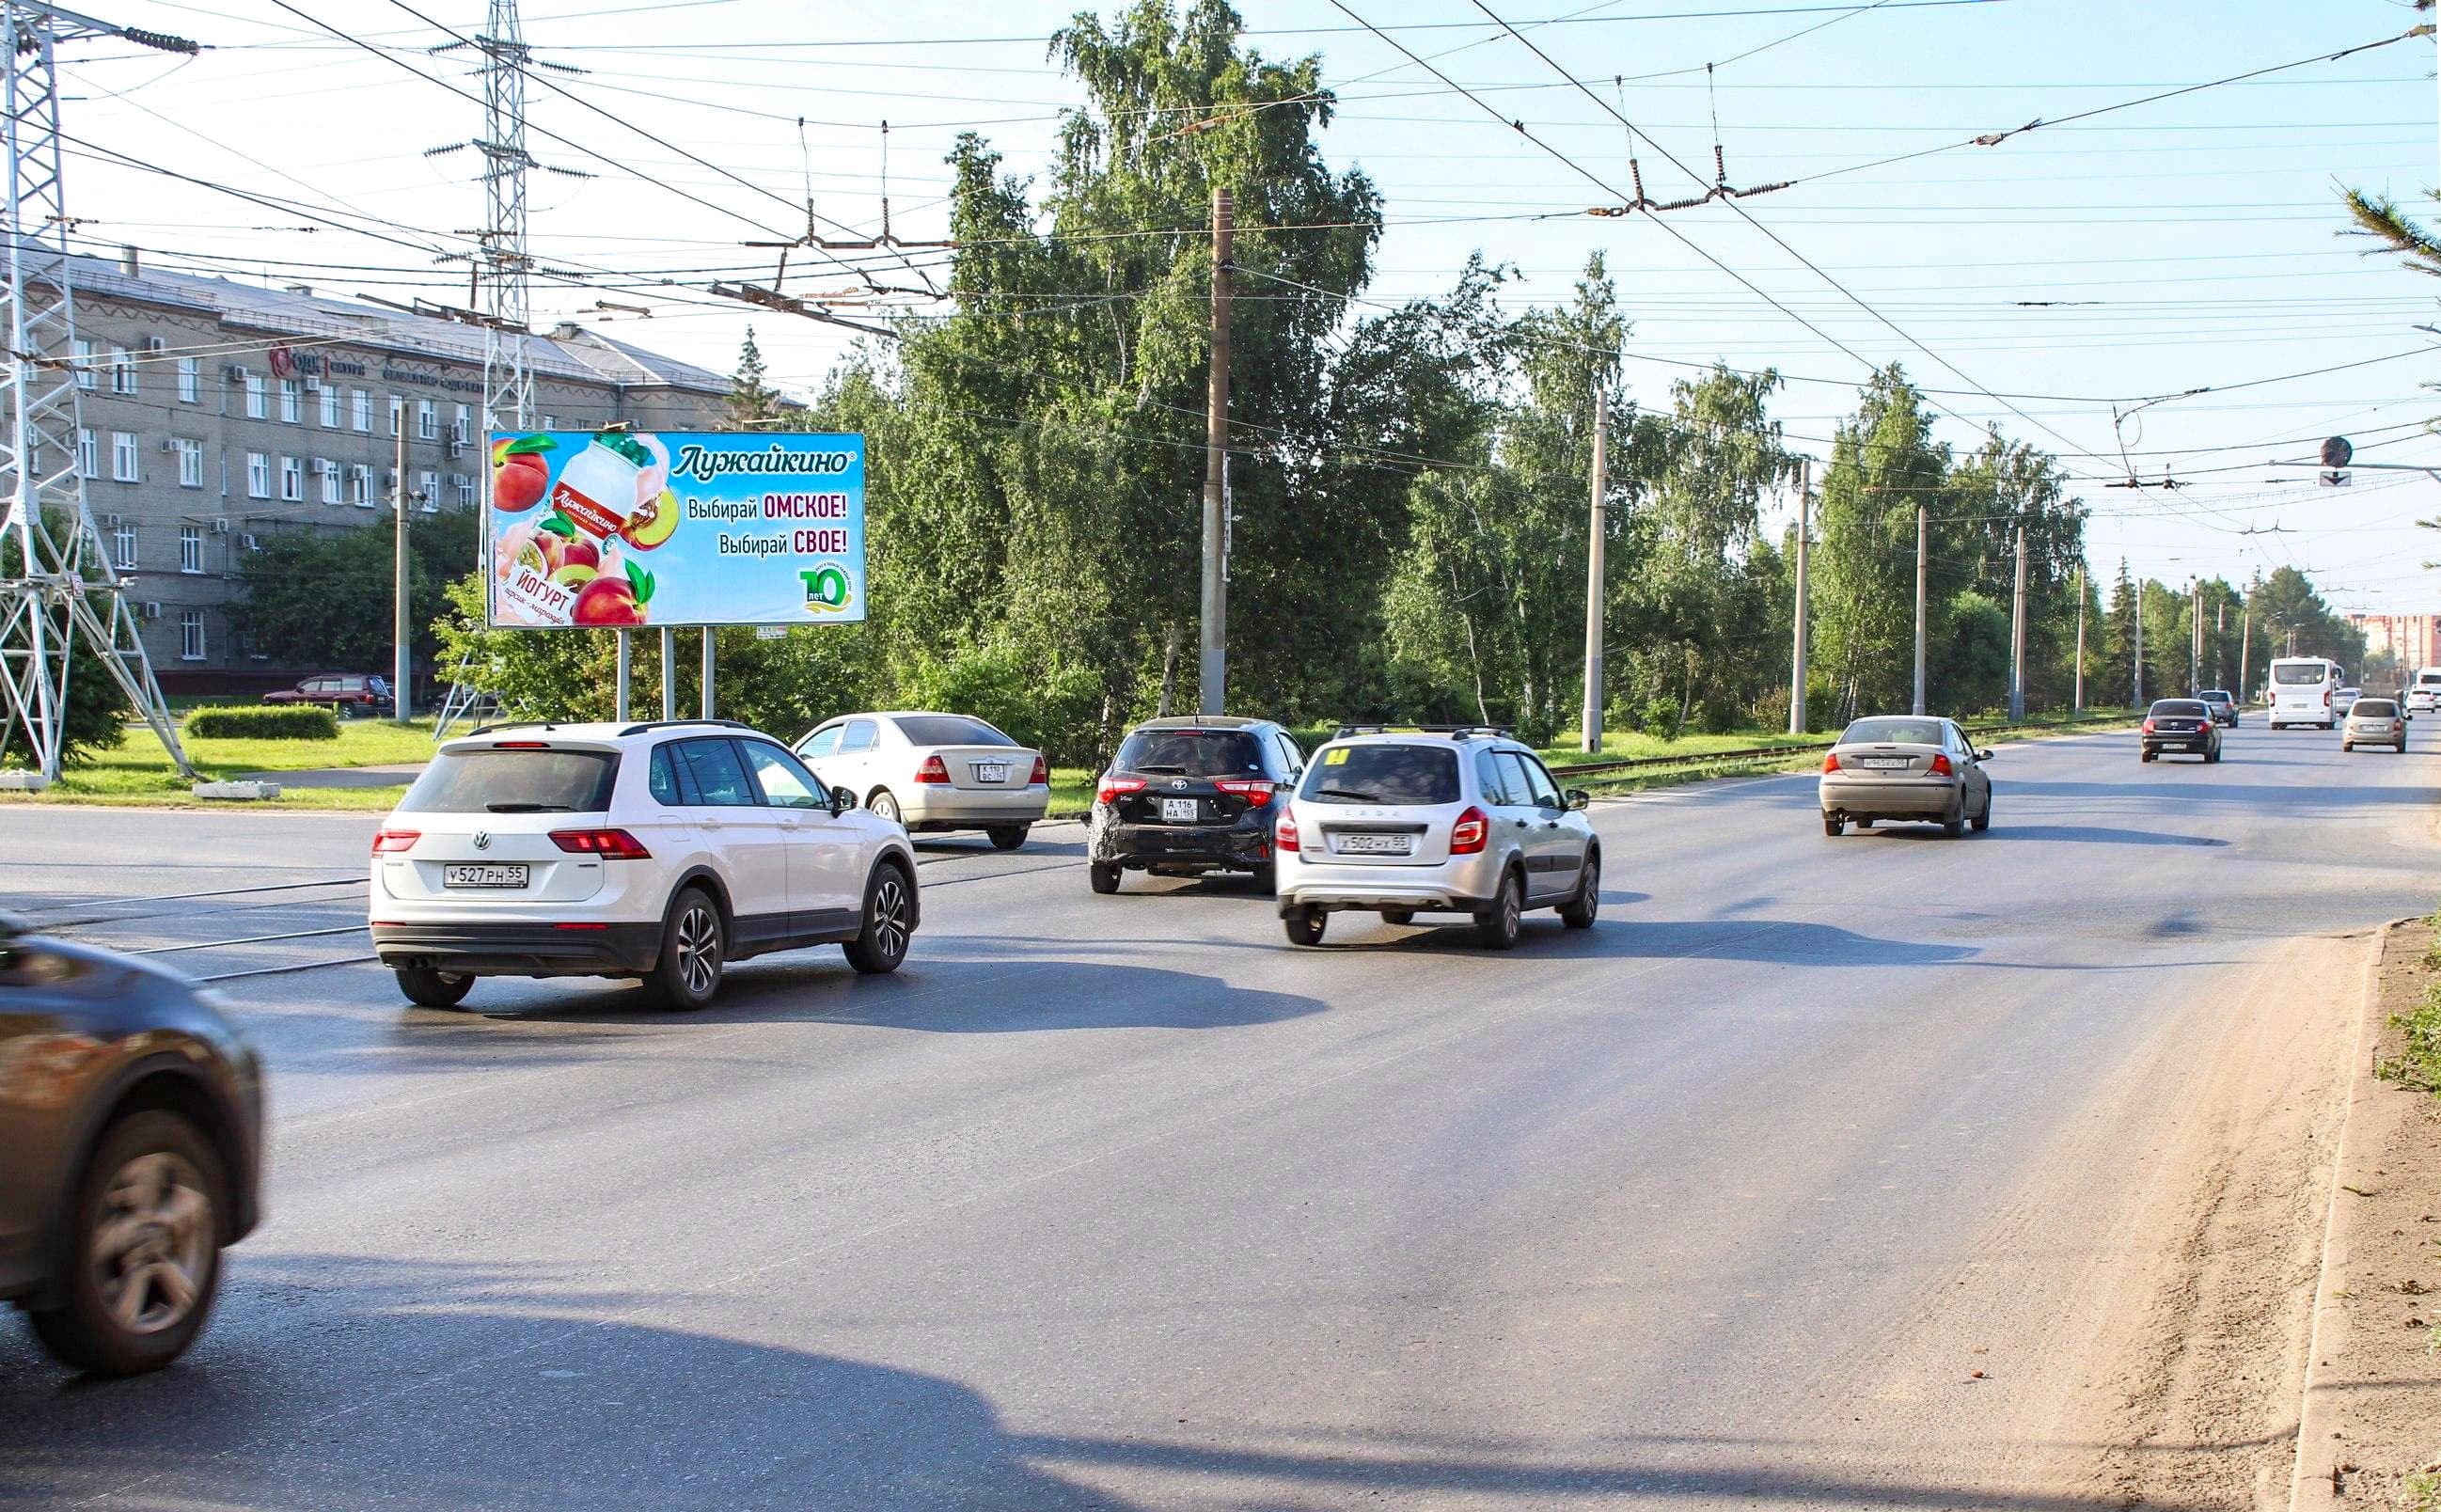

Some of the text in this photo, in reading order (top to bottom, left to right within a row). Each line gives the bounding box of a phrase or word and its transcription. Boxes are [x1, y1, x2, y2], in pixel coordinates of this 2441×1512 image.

[672, 446, 848, 481] Лужайкино
[555, 490, 617, 531] Лужайкино
[688, 495, 847, 522] Выбирай ОМСКОЕ!
[719, 530, 847, 558] Выбирай СВОЕ!
[516, 569, 569, 611] ЙОГУРТ
[800, 568, 846, 606] 10
